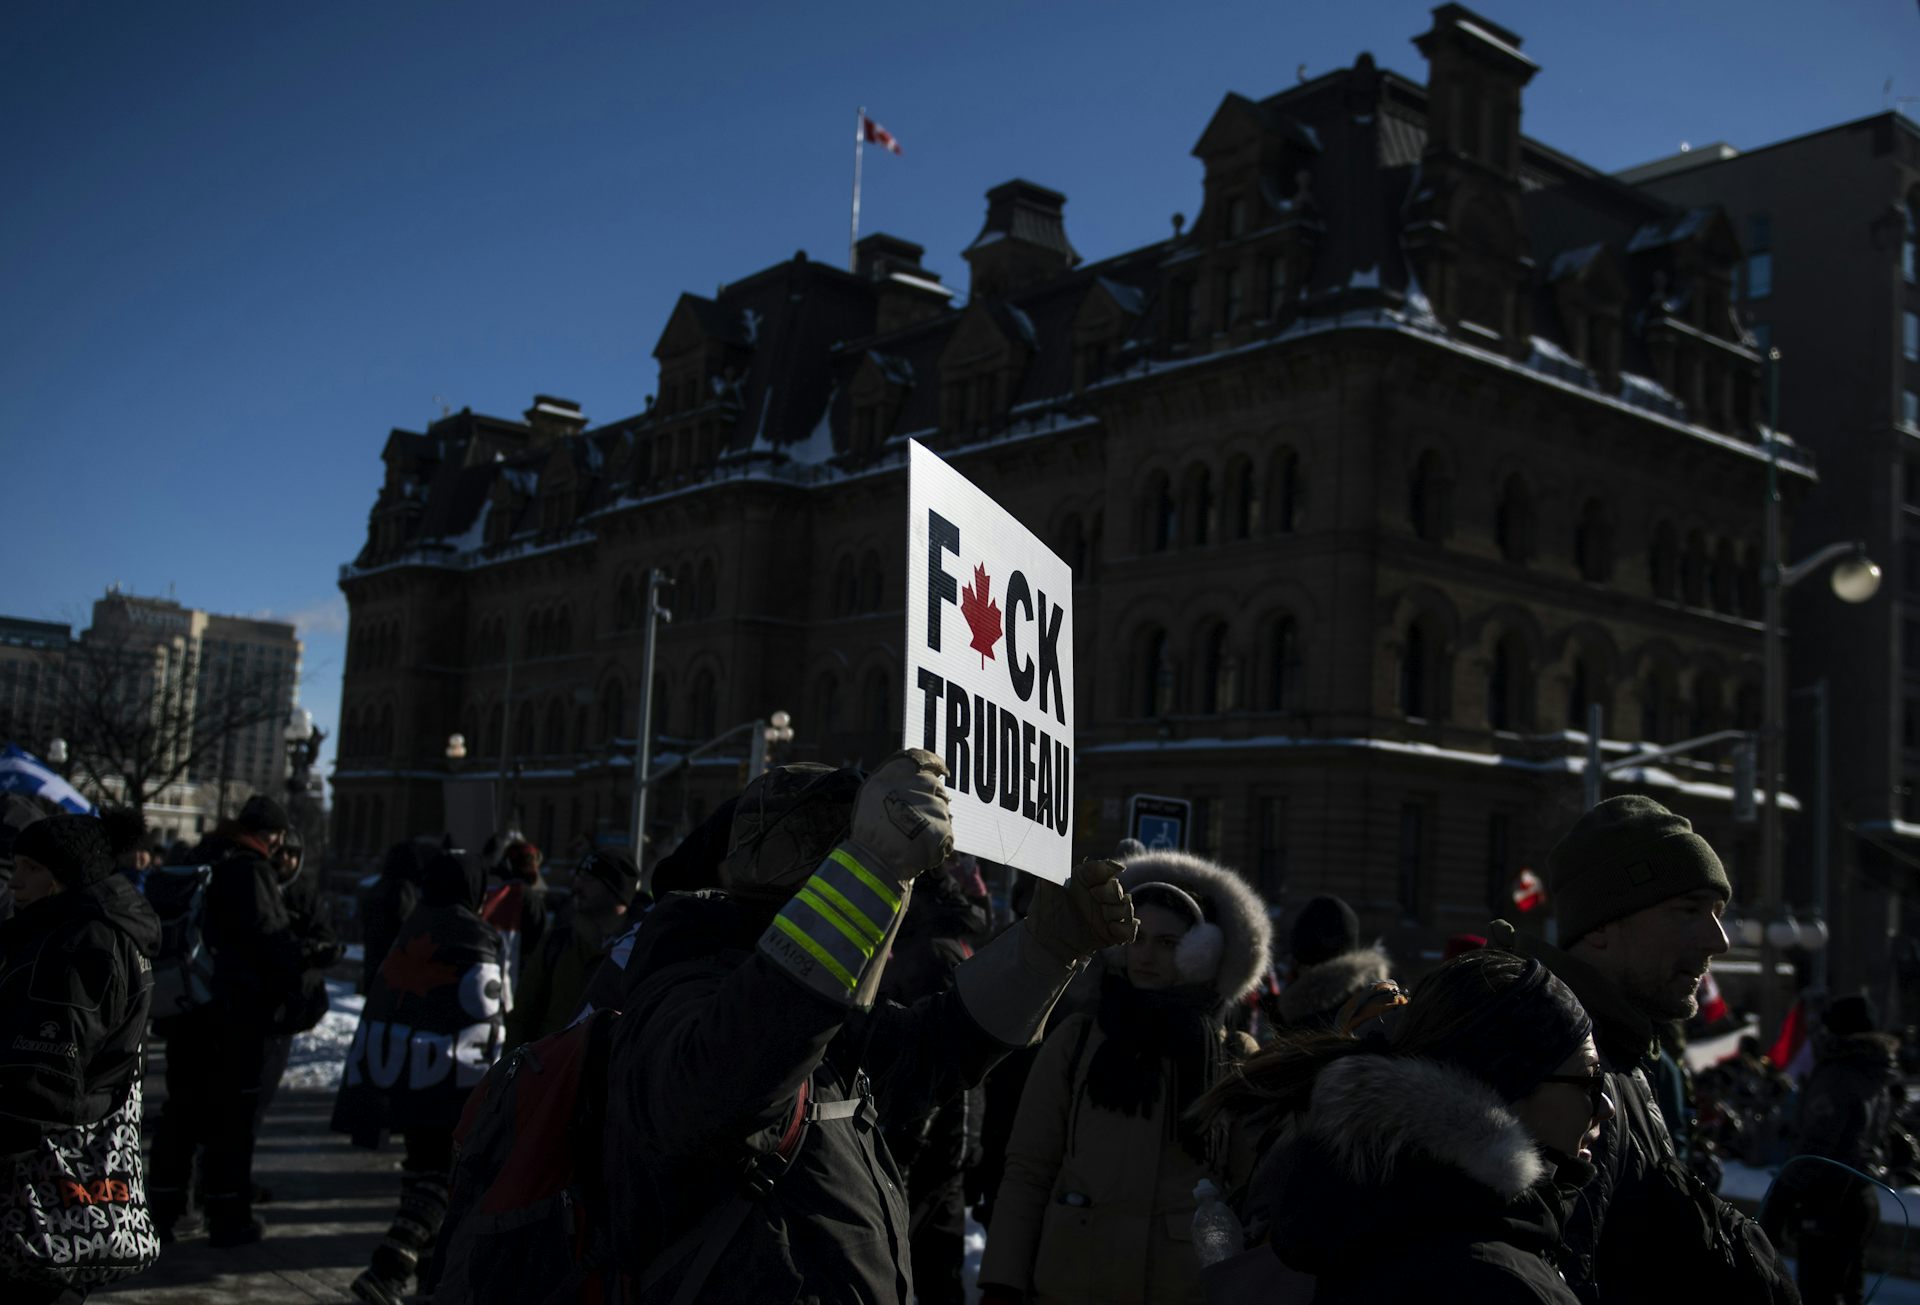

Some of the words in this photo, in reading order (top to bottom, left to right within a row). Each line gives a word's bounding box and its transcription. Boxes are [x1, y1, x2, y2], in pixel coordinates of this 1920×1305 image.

[917, 667, 1069, 836] TRUDEAU
[58, 1177, 130, 1208] PARIS
[31, 1203, 110, 1234] PARIS
[73, 1230, 138, 1263] PARIS
